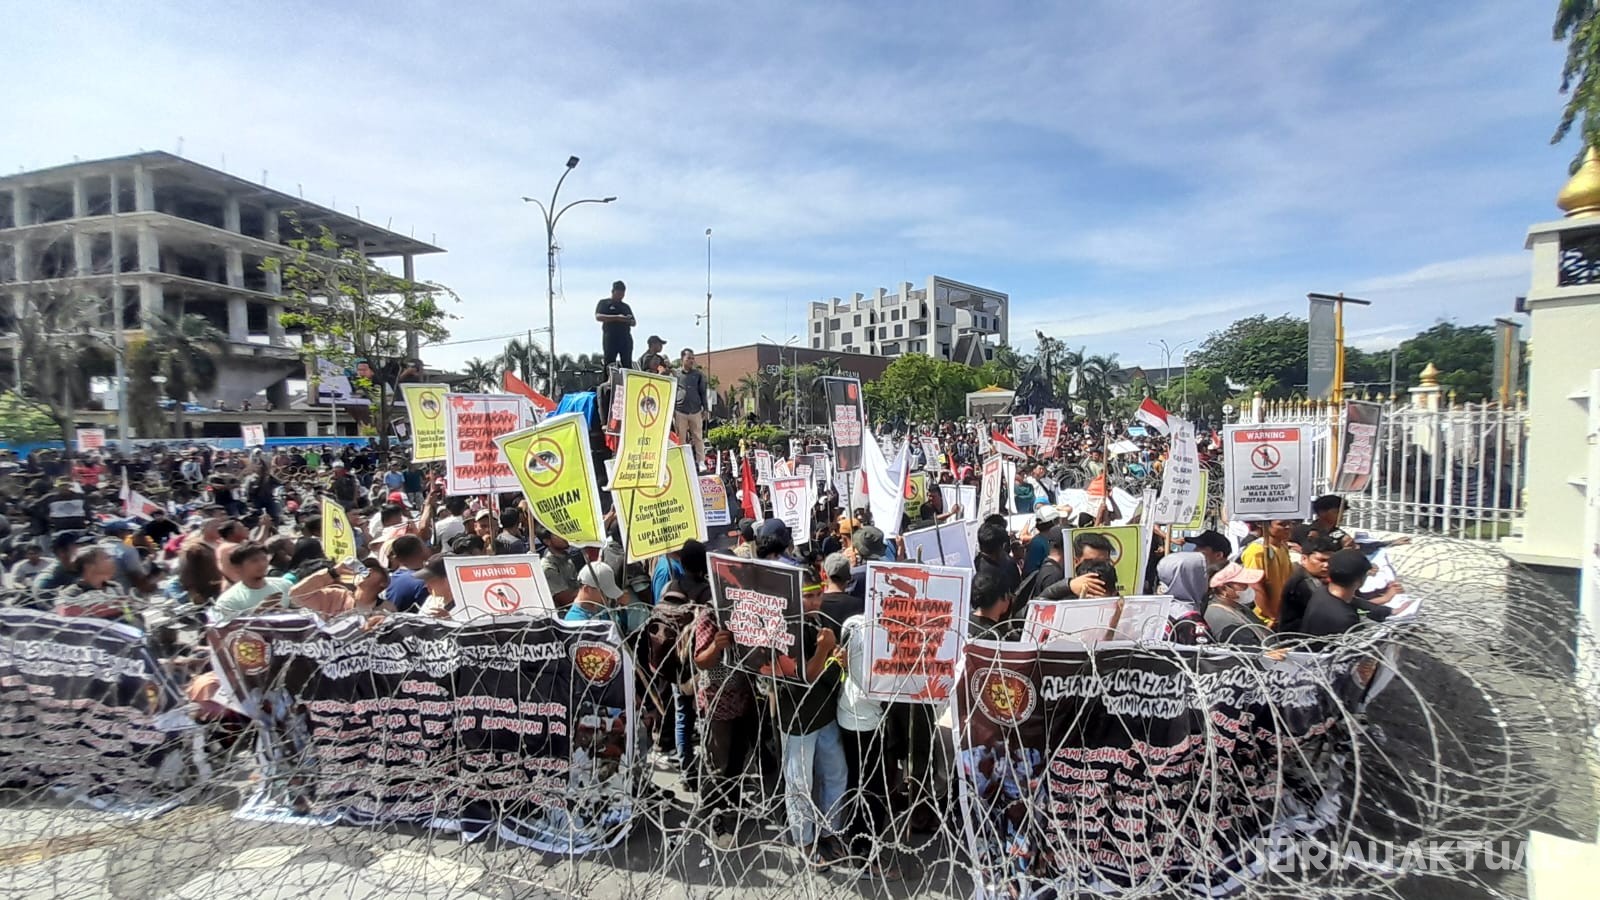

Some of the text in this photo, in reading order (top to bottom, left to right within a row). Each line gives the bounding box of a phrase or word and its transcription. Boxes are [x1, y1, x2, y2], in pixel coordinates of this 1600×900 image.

[1247, 431, 1286, 440] WARNING
[475, 453, 497, 462] DAN
[536, 488, 581, 514] KEBIJAKAN
[639, 497, 678, 513] Pemerintah
[550, 508, 571, 524] BUTA
[635, 503, 685, 522] Sibuk Lindungi
[637, 522, 689, 541] LUPA LINDUNGI
[649, 533, 681, 546] MANUSIA!
[473, 567, 517, 577] WARNING
[727, 589, 786, 608] PEMERINTAH
[884, 600, 908, 612] HATI
